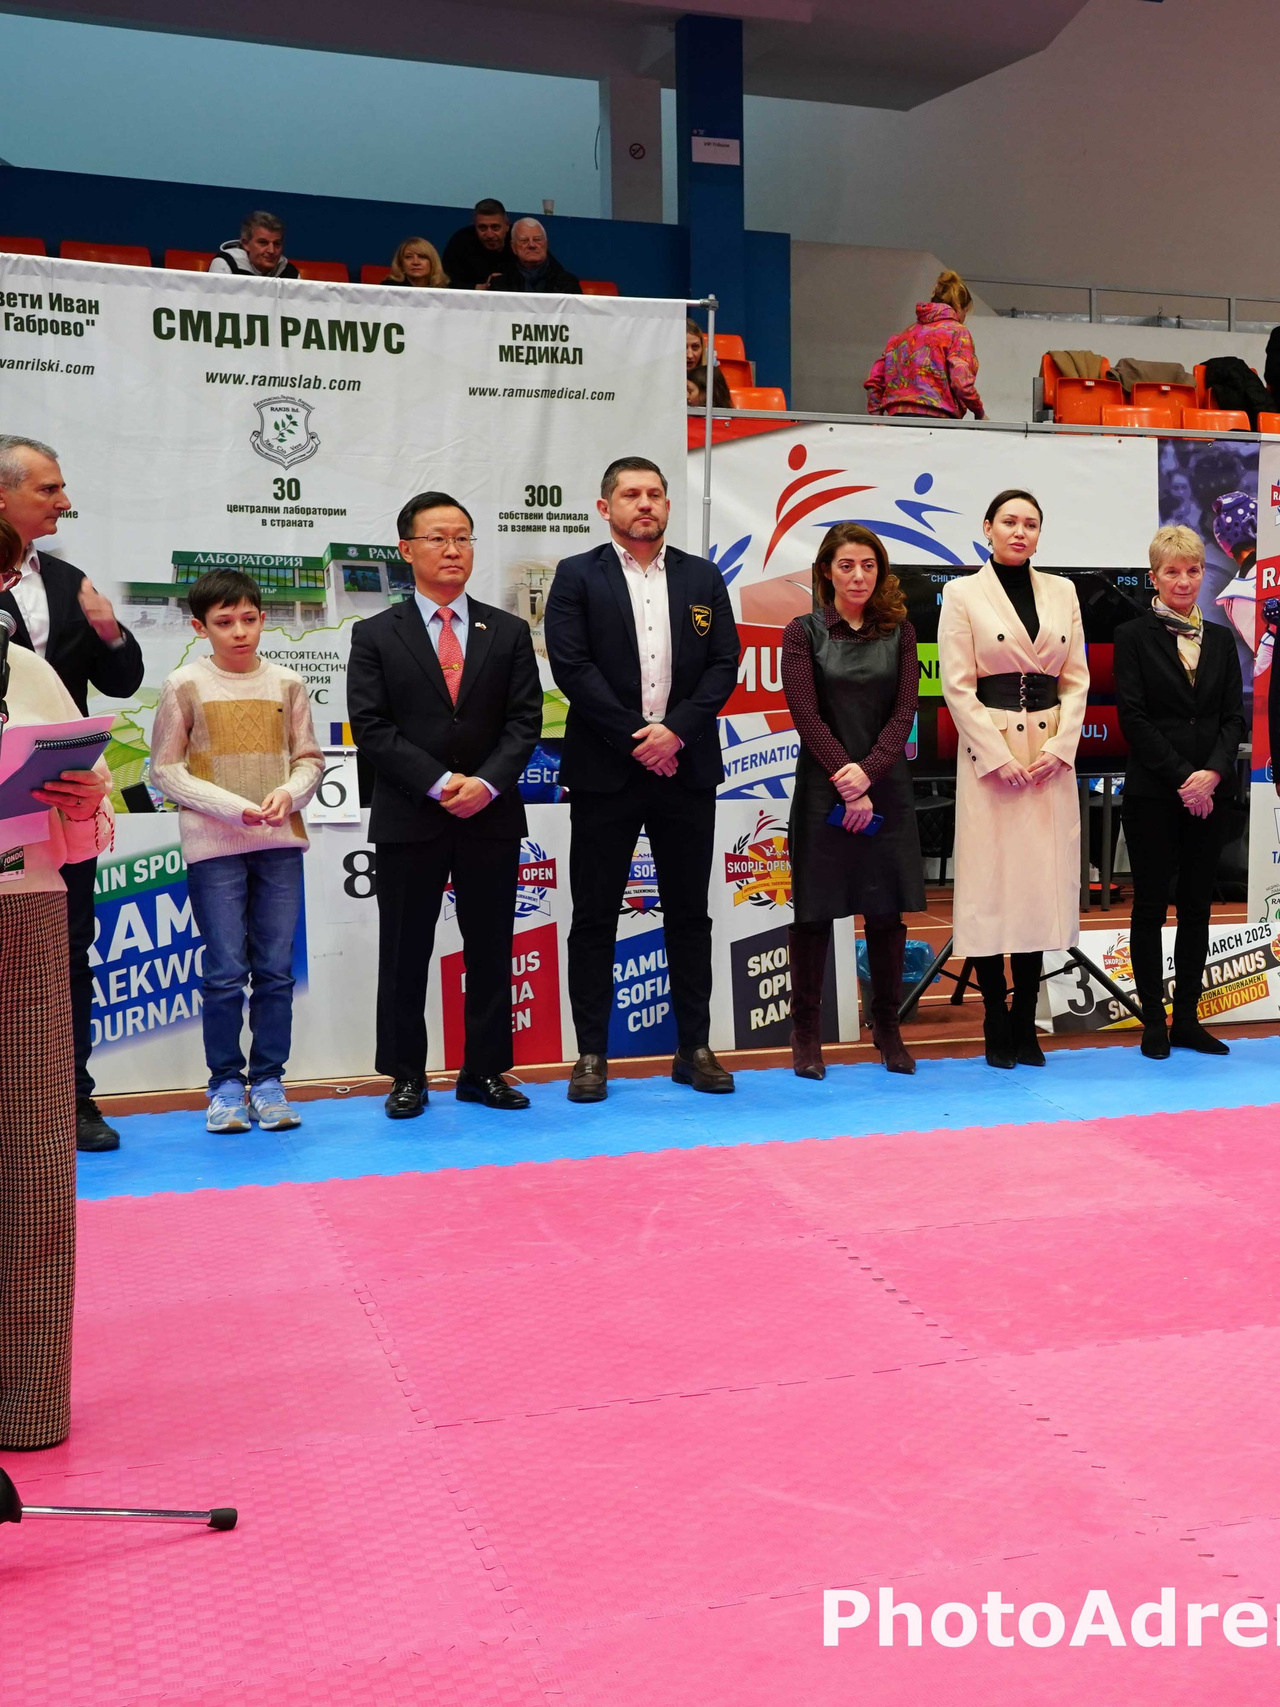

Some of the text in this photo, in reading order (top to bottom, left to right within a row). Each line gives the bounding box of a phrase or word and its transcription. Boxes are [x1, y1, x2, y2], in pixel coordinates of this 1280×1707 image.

[49, 292, 99, 315] Иван
[153, 307, 405, 354] СМДЛ РАМУС
[512, 323, 570, 342] РАМУС
[498, 345, 583, 365] МЕДИКАЛ
[205, 371, 361, 391] www.ramuslab.com
[468, 386, 615, 401] www.ramusmedical.com
[273, 478, 300, 501] 30
[525, 485, 562, 507] 300
[226, 504, 346, 516] централни лаборатории
[499, 511, 588, 521] собствени филиала
[270, 519, 314, 528] страната
[498, 524, 508, 532] за
[563, 525, 590, 533] проби
[194, 553, 303, 567] ЛАБОРАТОРИЯ
[1117, 576, 1138, 585] PSS
[316, 764, 347, 808] 6
[522, 867, 553, 881] OPEN
[727, 860, 792, 873] SKOPJE OPEN
[1208, 933, 1243, 957] ARCH
[1245, 923, 1272, 944] 2025
[1211, 950, 1267, 986] RAMUS
[1063, 958, 1096, 1016] 3
[1225, 974, 1265, 992] TOURNAMENT
[627, 1001, 670, 1033] CUP
